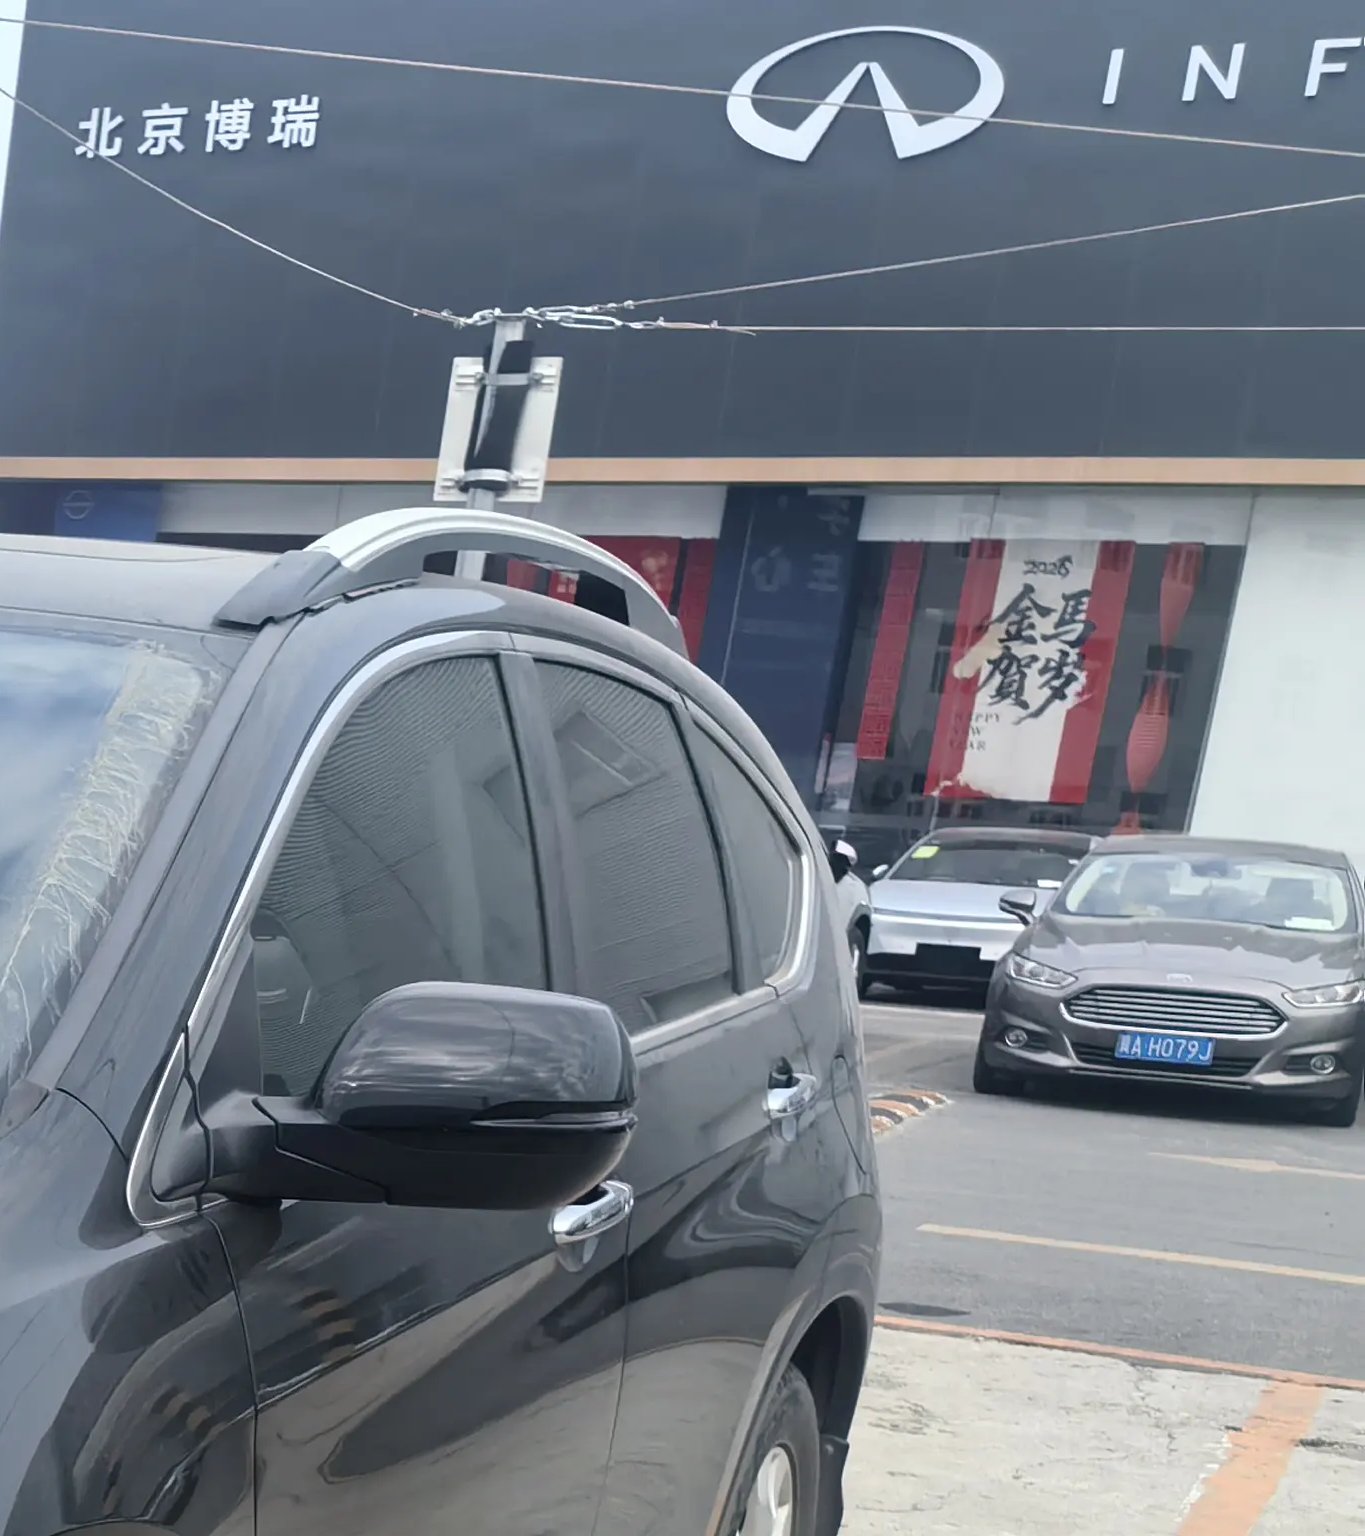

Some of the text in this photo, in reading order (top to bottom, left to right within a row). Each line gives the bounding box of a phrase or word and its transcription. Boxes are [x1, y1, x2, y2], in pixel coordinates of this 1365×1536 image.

[1102, 37, 1365, 104] INF
[75, 94, 320, 158] 北京博瑞
